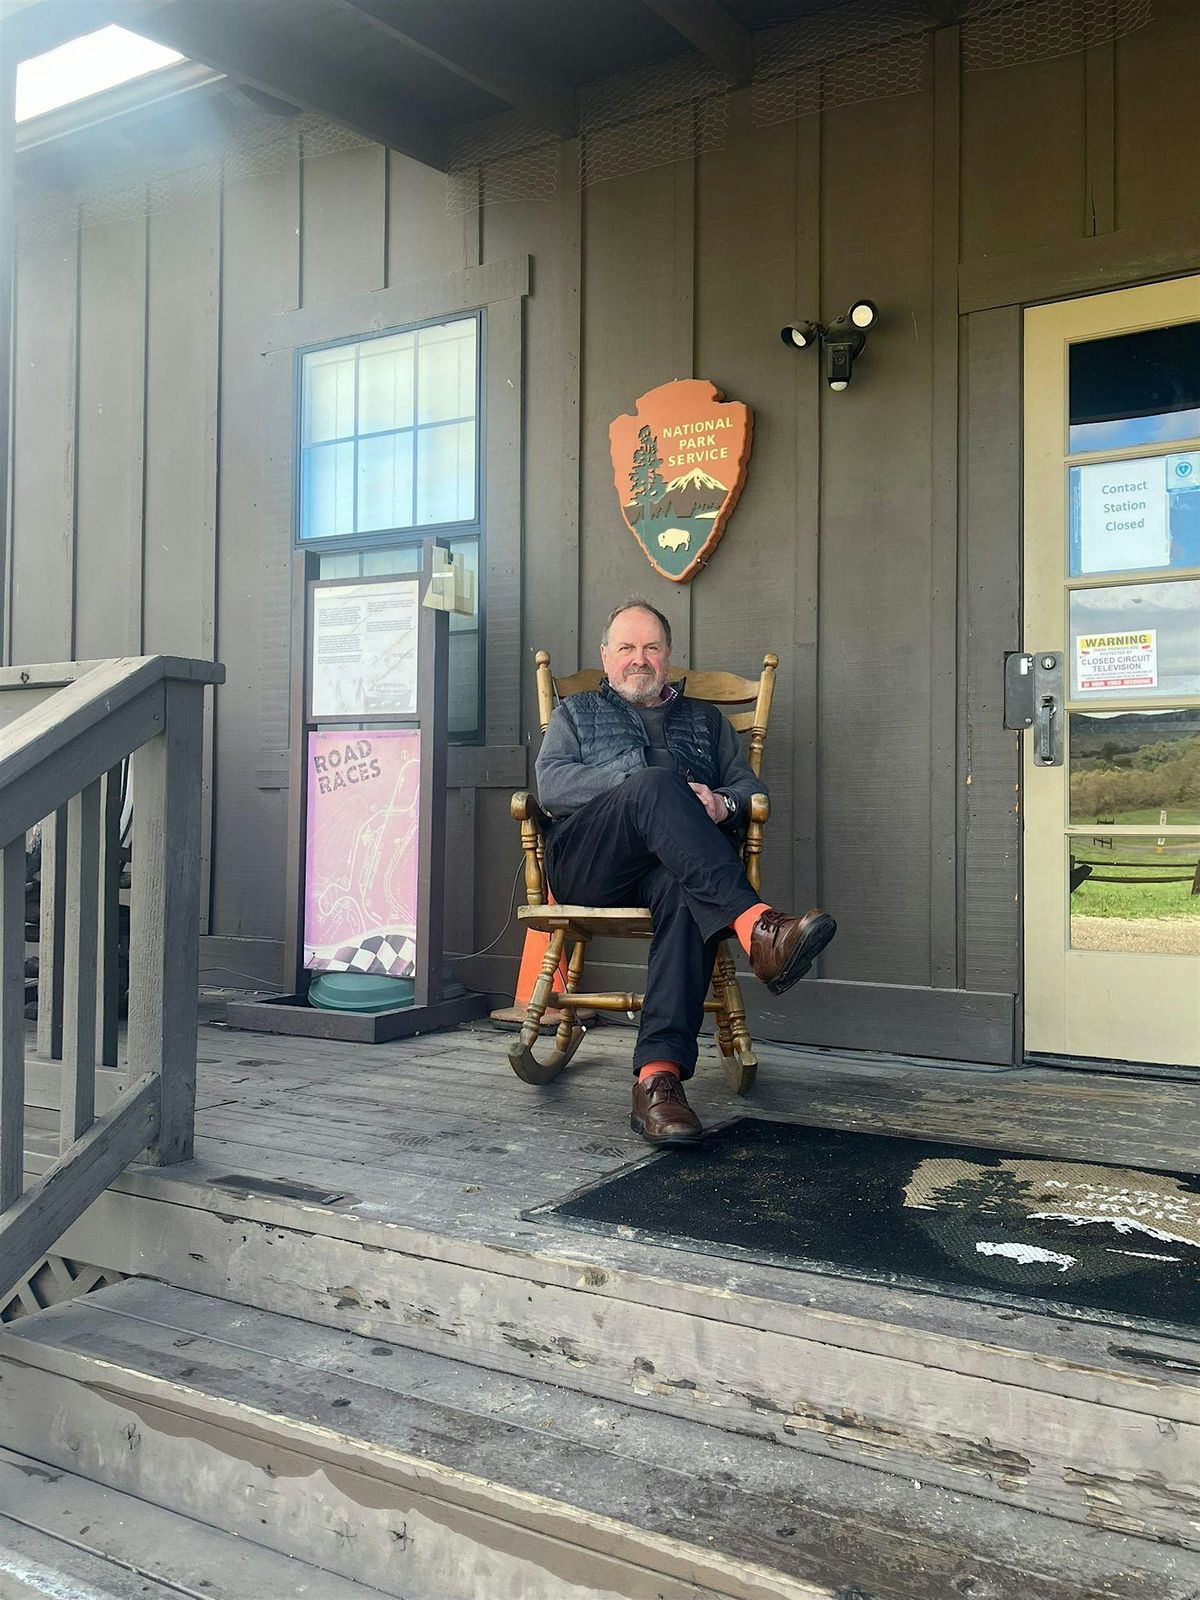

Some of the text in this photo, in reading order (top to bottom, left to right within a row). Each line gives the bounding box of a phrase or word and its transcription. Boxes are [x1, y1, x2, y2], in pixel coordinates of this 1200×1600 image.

[662, 417, 733, 439] NATIONAL
[679, 434, 716, 451] PARK
[667, 447, 729, 467] SERVICE
[1101, 481, 1148, 495] Contact
[1103, 500, 1146, 513] Station
[1105, 518, 1145, 532] Closed
[1085, 634, 1147, 648] WARNING
[1081, 654, 1150, 666] CLOSED CIRCUIT
[1092, 663, 1141, 672] TELEVISION
[314, 739, 372, 774] ROAD
[318, 758, 381, 794] RACES
[1050, 1197, 1200, 1225] SERVIC
